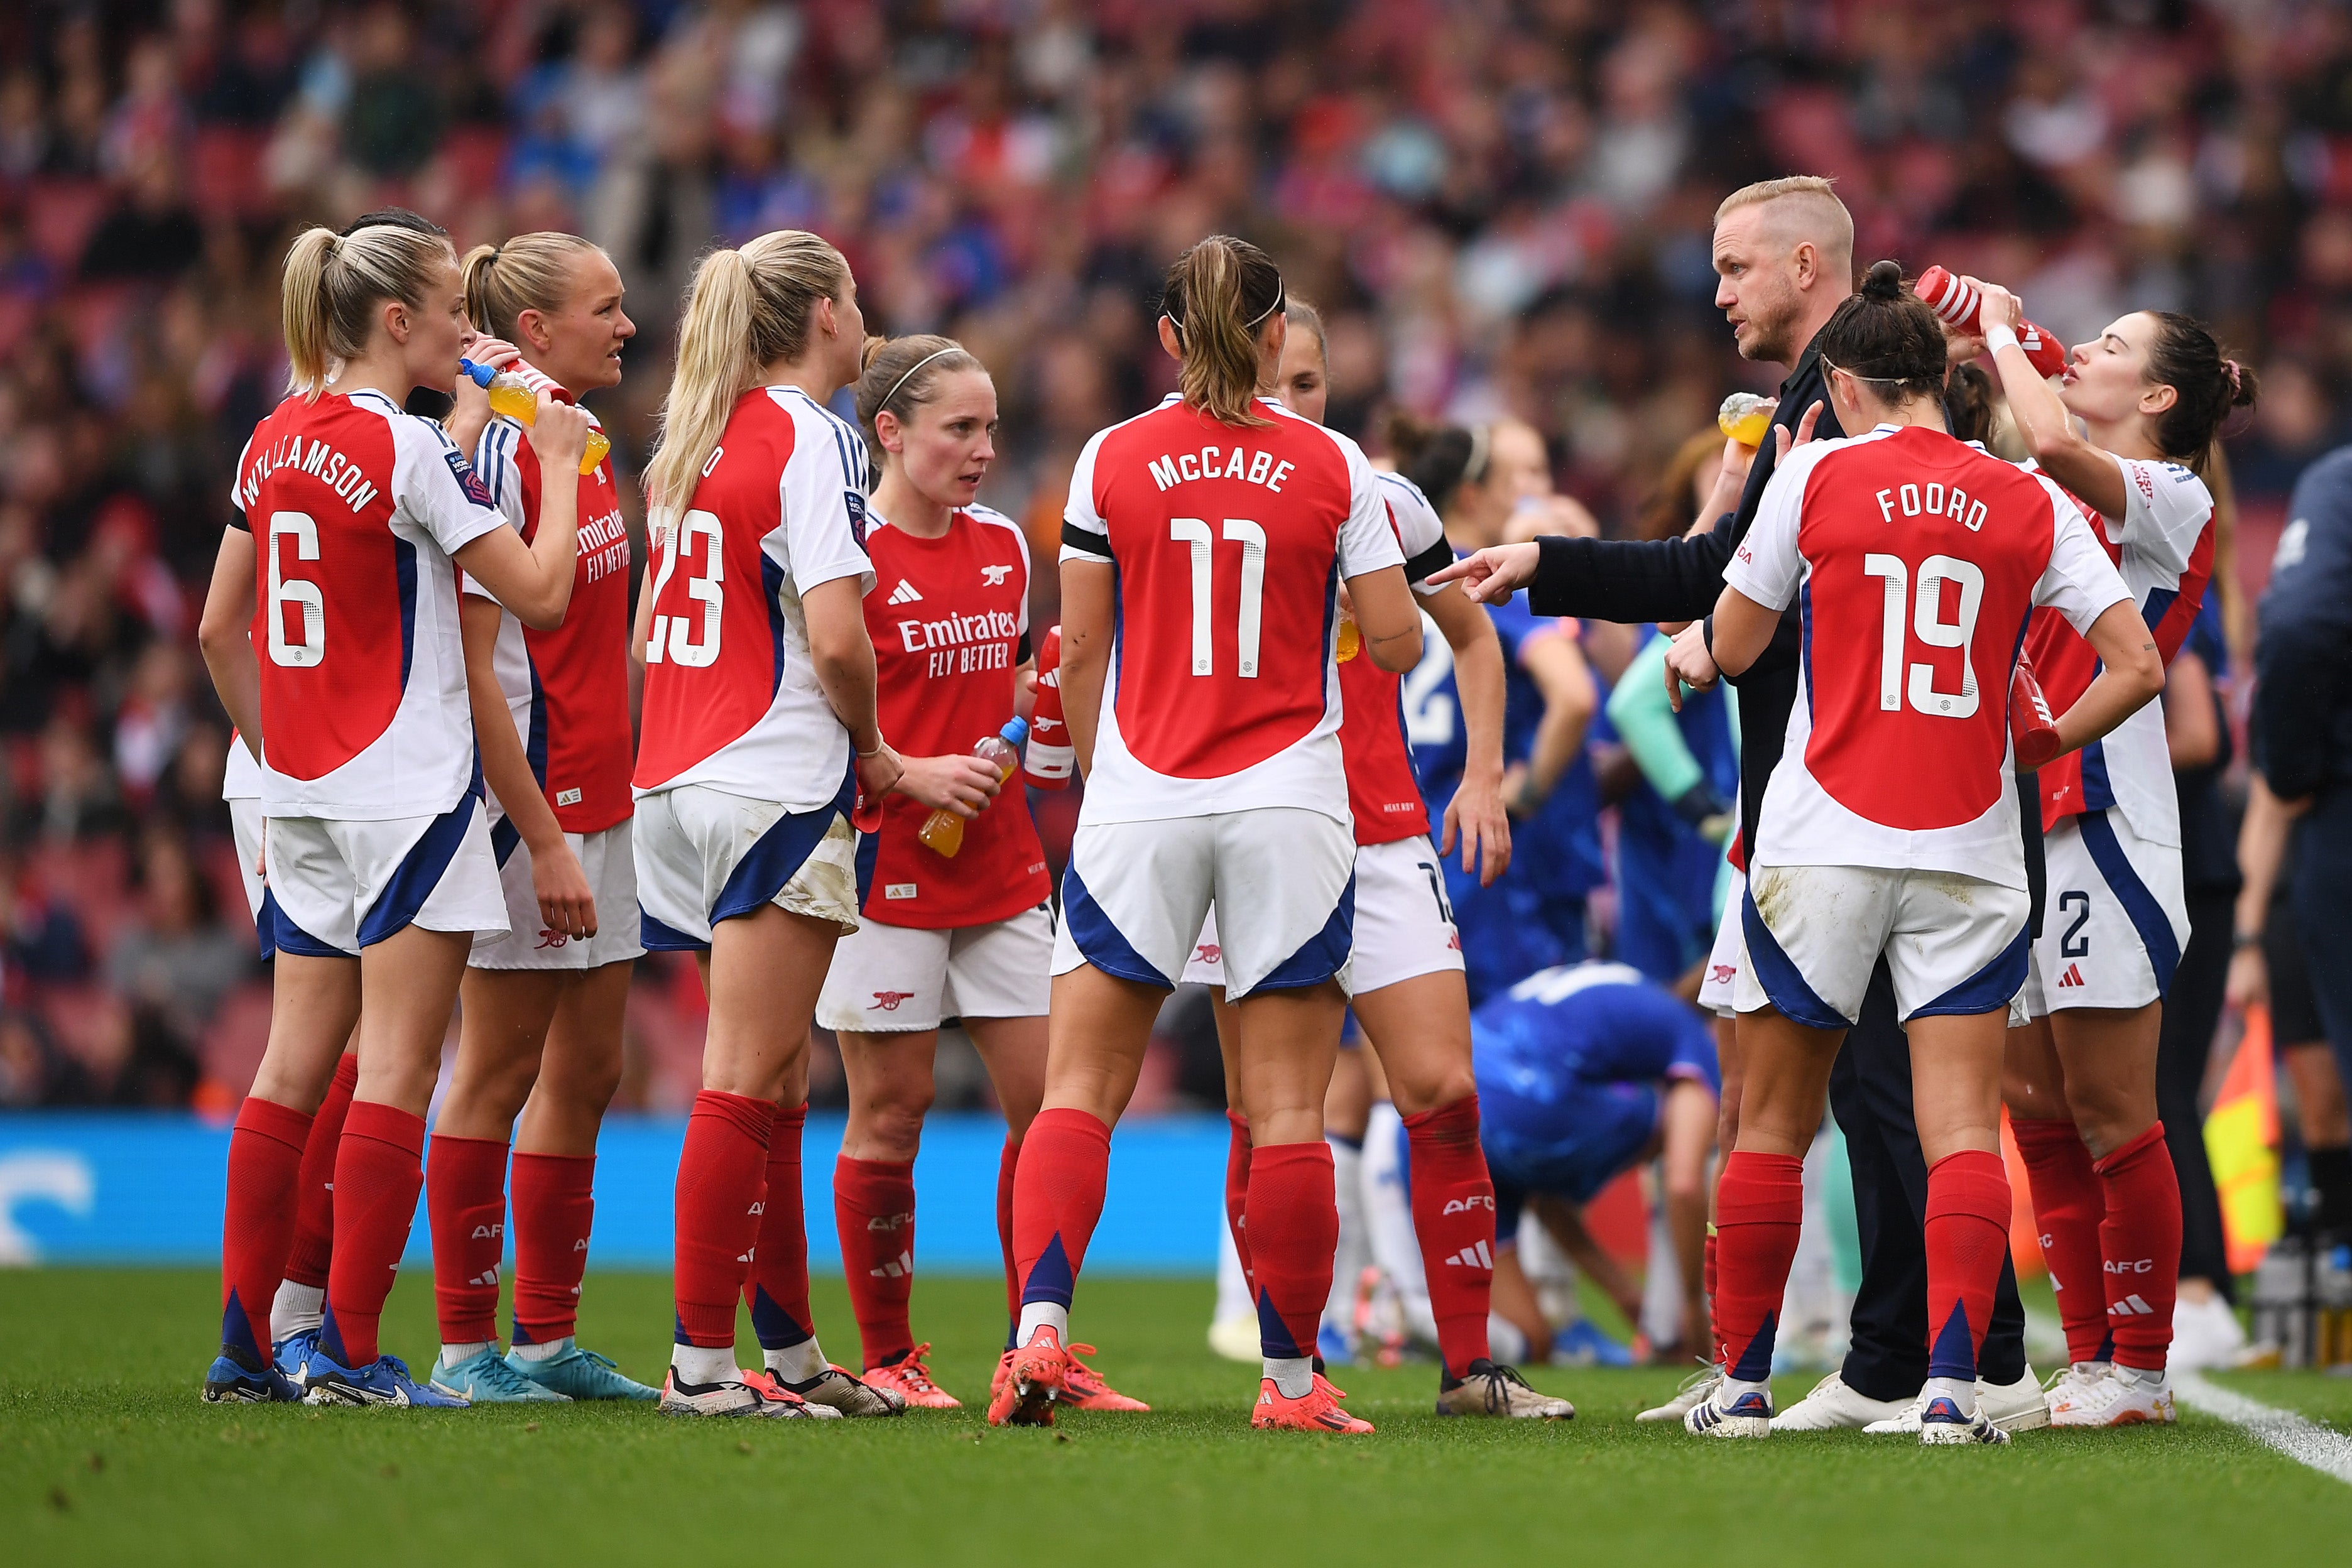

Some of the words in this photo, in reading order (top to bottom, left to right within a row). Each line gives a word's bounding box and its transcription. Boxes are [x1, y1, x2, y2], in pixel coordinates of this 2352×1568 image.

[241, 435, 378, 514] WILLIAMSON
[1147, 445, 1295, 493] McCABE
[1875, 482, 1988, 532] FOORD
[577, 508, 625, 557] mirate
[268, 511, 325, 668] 6
[587, 552, 603, 584] FLY
[645, 506, 724, 668] 23
[1170, 518, 1266, 678] 11
[898, 609, 1016, 653] Emirates
[1863, 553, 1985, 719] 19
[928, 646, 954, 678] FLY
[960, 642, 1008, 673] BETTER
[2059, 890, 2089, 958] 2
[472, 1224, 504, 1239] AF
[2103, 1258, 2152, 1274] AFC
